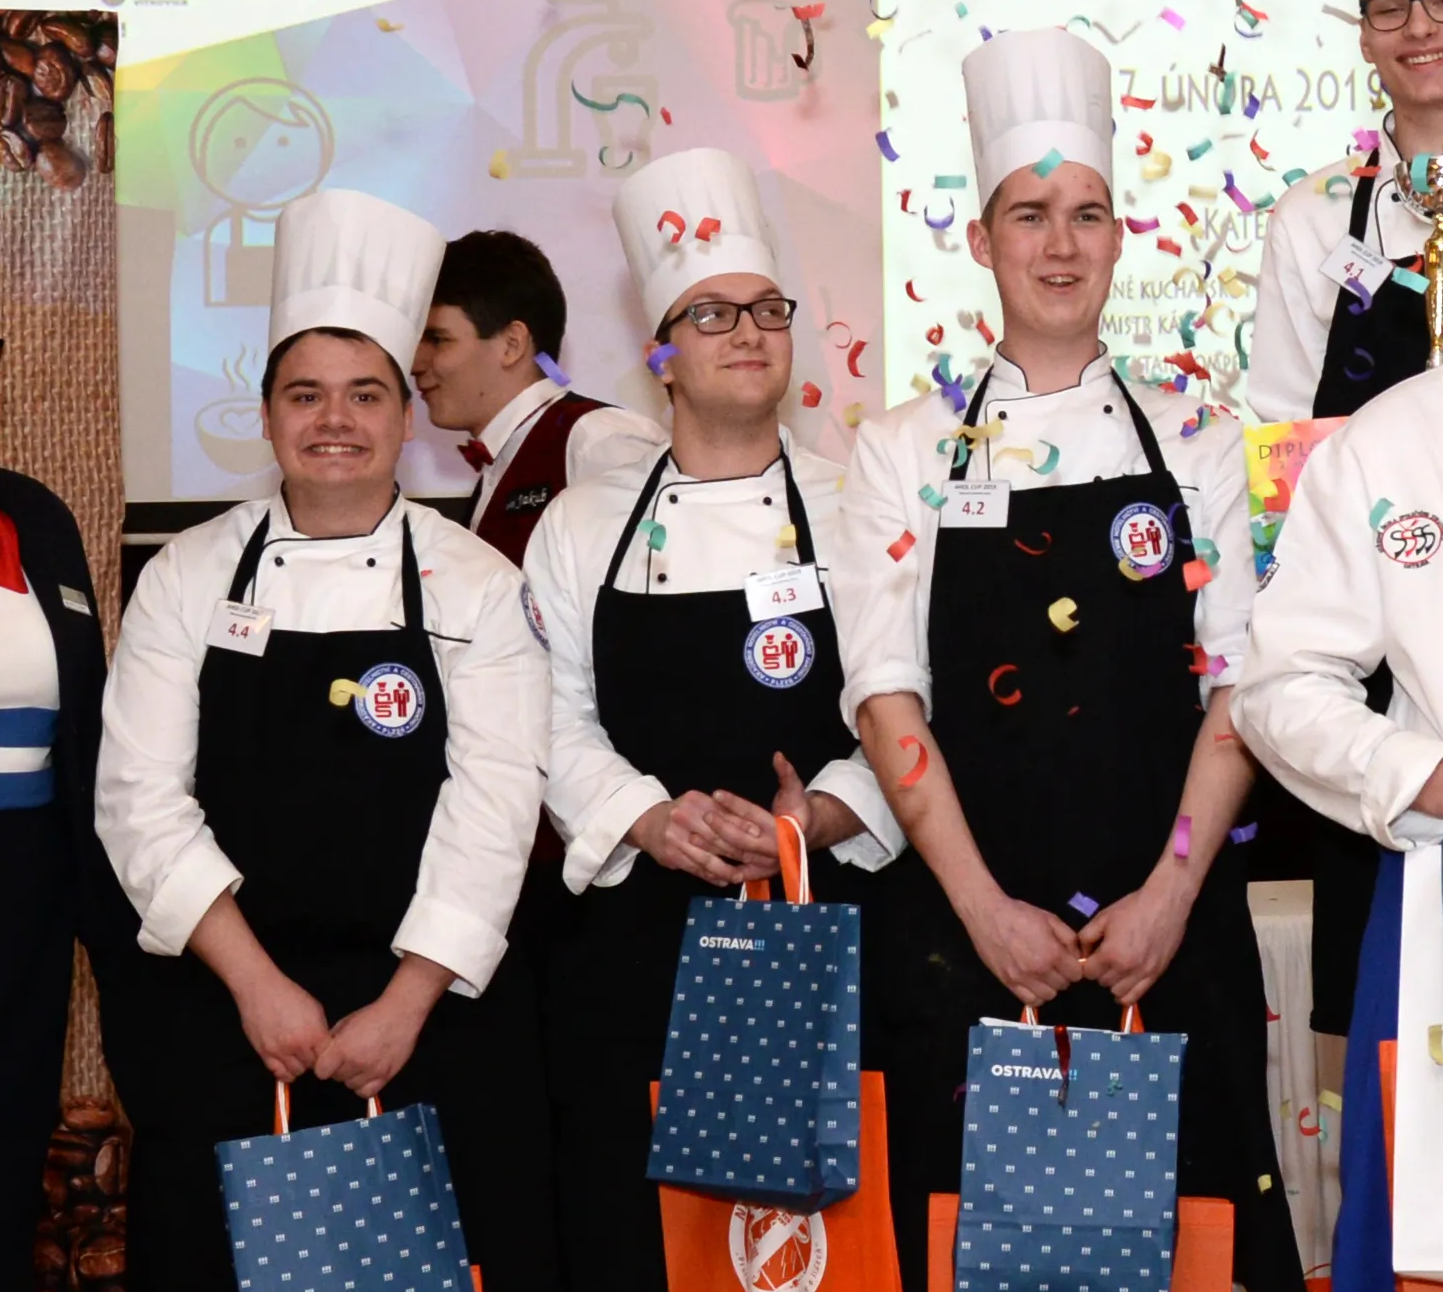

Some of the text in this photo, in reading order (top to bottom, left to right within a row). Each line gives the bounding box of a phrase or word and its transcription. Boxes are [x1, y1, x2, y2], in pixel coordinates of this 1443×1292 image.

[1344, 262, 1364, 280] 4.1
[961, 502, 985, 516] 4.2
[771, 587, 797, 605] 4.3
[228, 622, 251, 639] 4.4
[991, 1065, 1078, 1081] OSTRAVA!!
